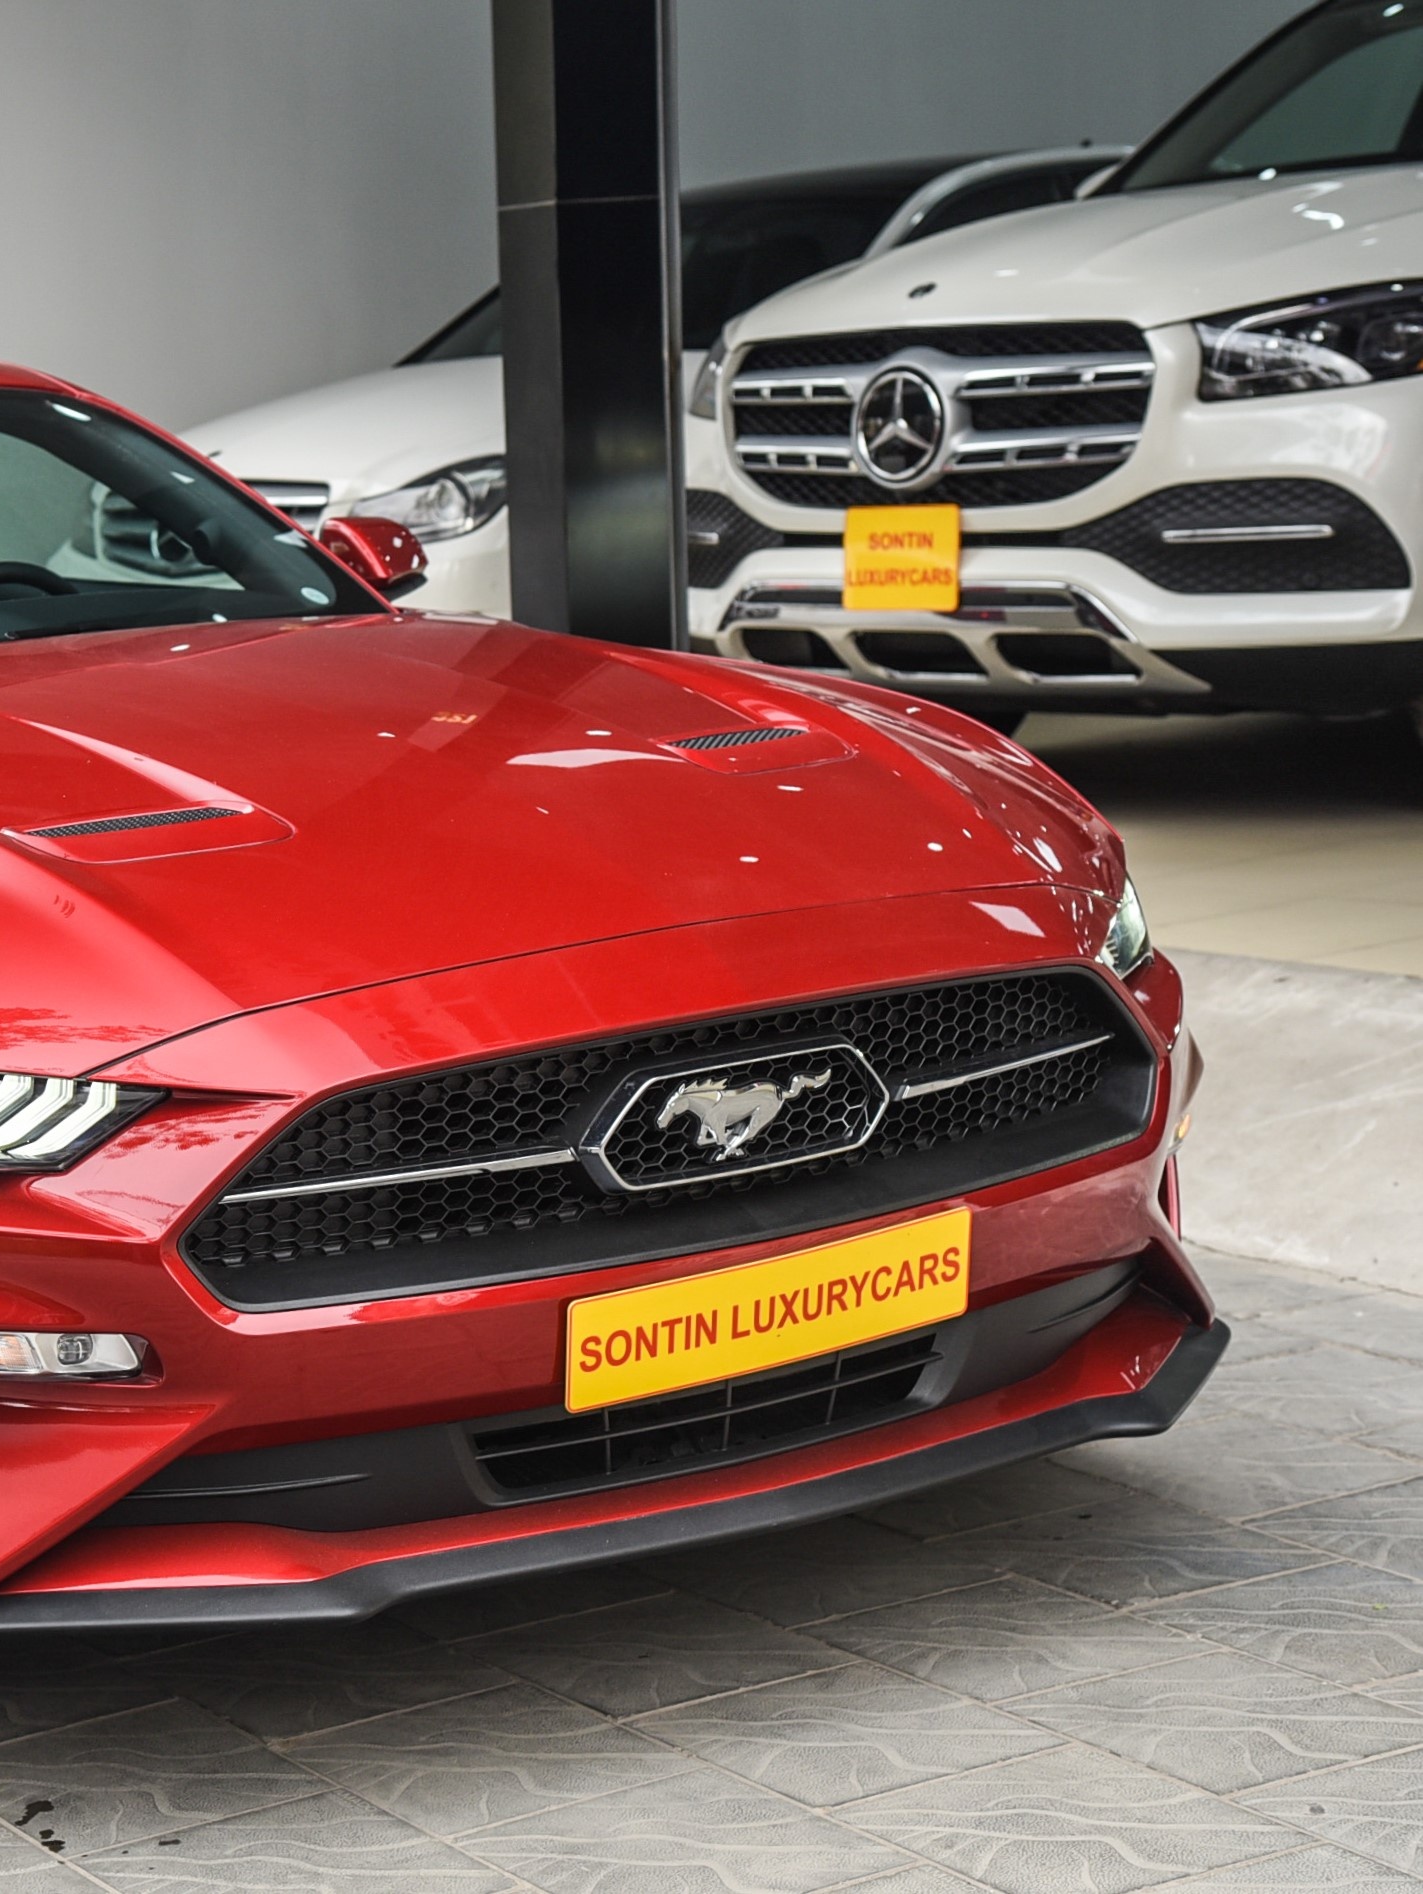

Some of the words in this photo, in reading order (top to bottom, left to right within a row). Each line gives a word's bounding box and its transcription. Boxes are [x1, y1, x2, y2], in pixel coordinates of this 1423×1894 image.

[869, 532, 933, 550] SONTIN
[848, 567, 953, 587] LUXURYCARS
[579, 1309, 718, 1373] SONTIN
[731, 1246, 960, 1340] LUXURYCARS
